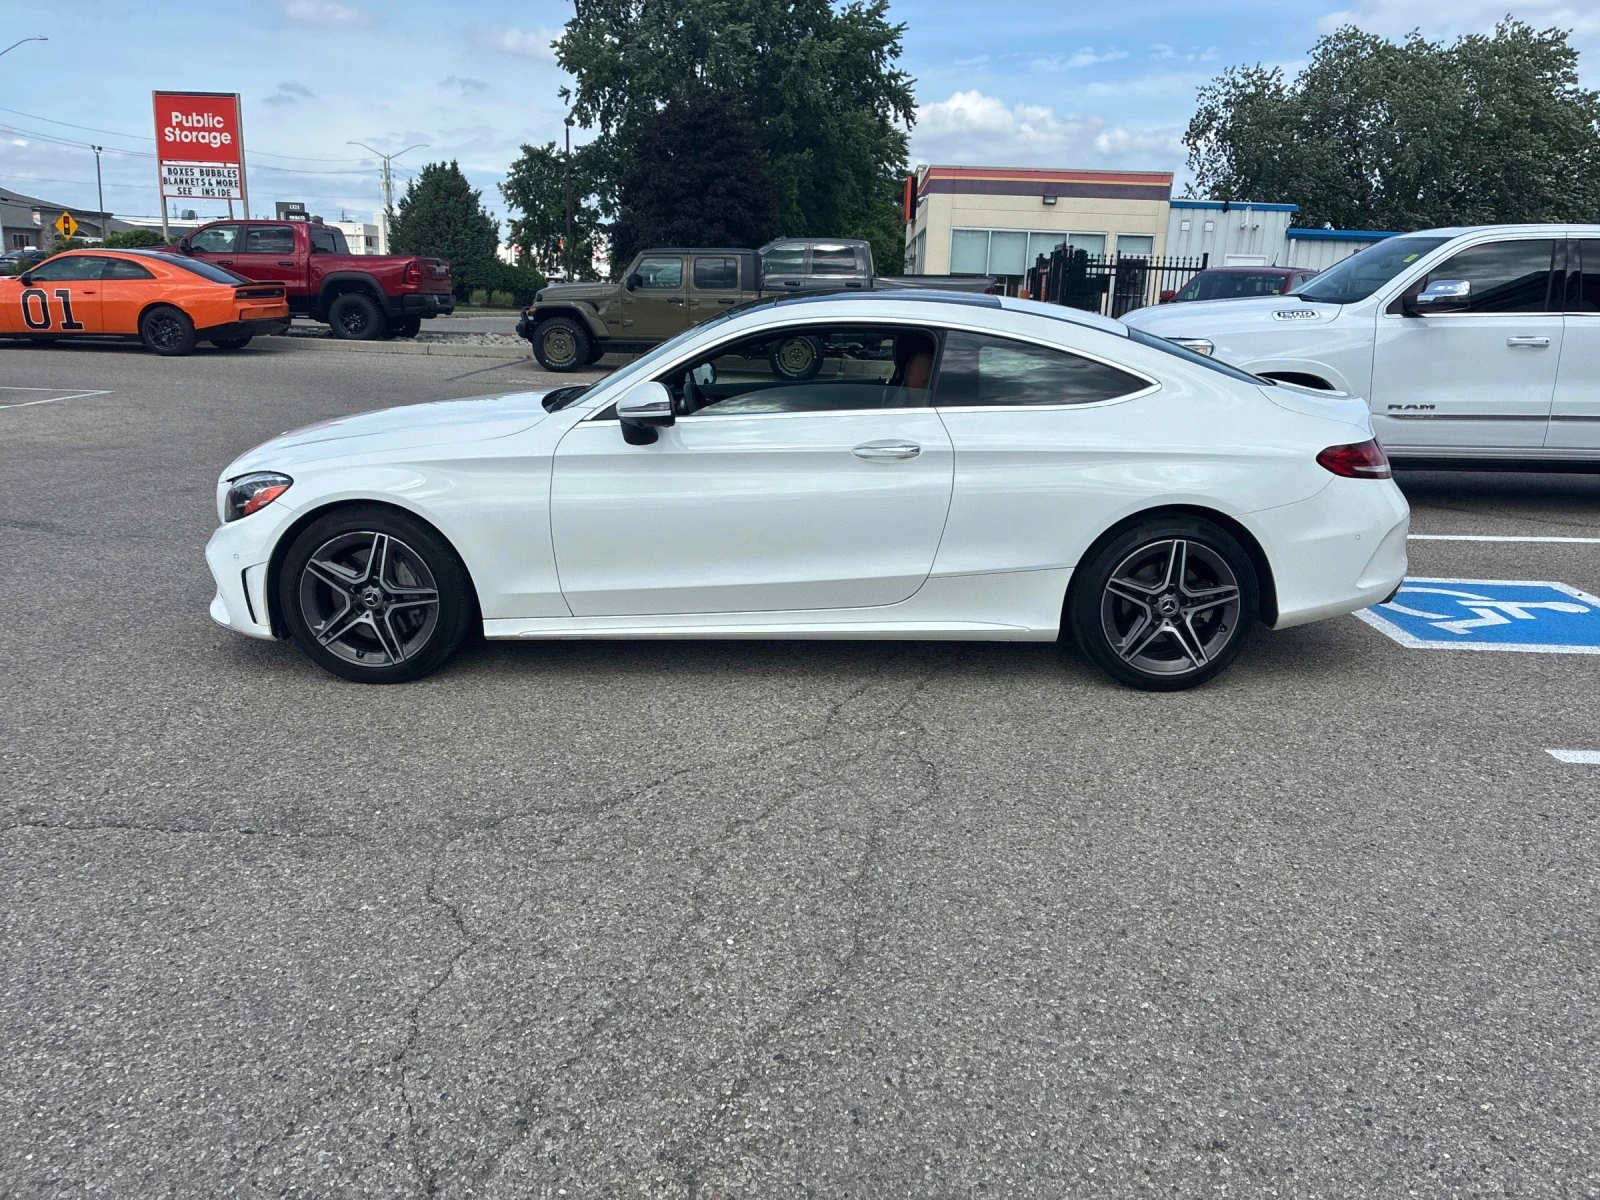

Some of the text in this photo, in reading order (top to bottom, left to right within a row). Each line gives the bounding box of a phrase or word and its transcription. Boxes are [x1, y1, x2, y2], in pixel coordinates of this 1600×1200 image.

[171, 112, 224, 128] Public
[164, 127, 231, 148] Storage
[167, 167, 238, 178] BOXES BUBBLES
[163, 176, 239, 188] BLANKETS & MORE
[177, 186, 193, 196] SEE
[20, 288, 85, 331] 01
